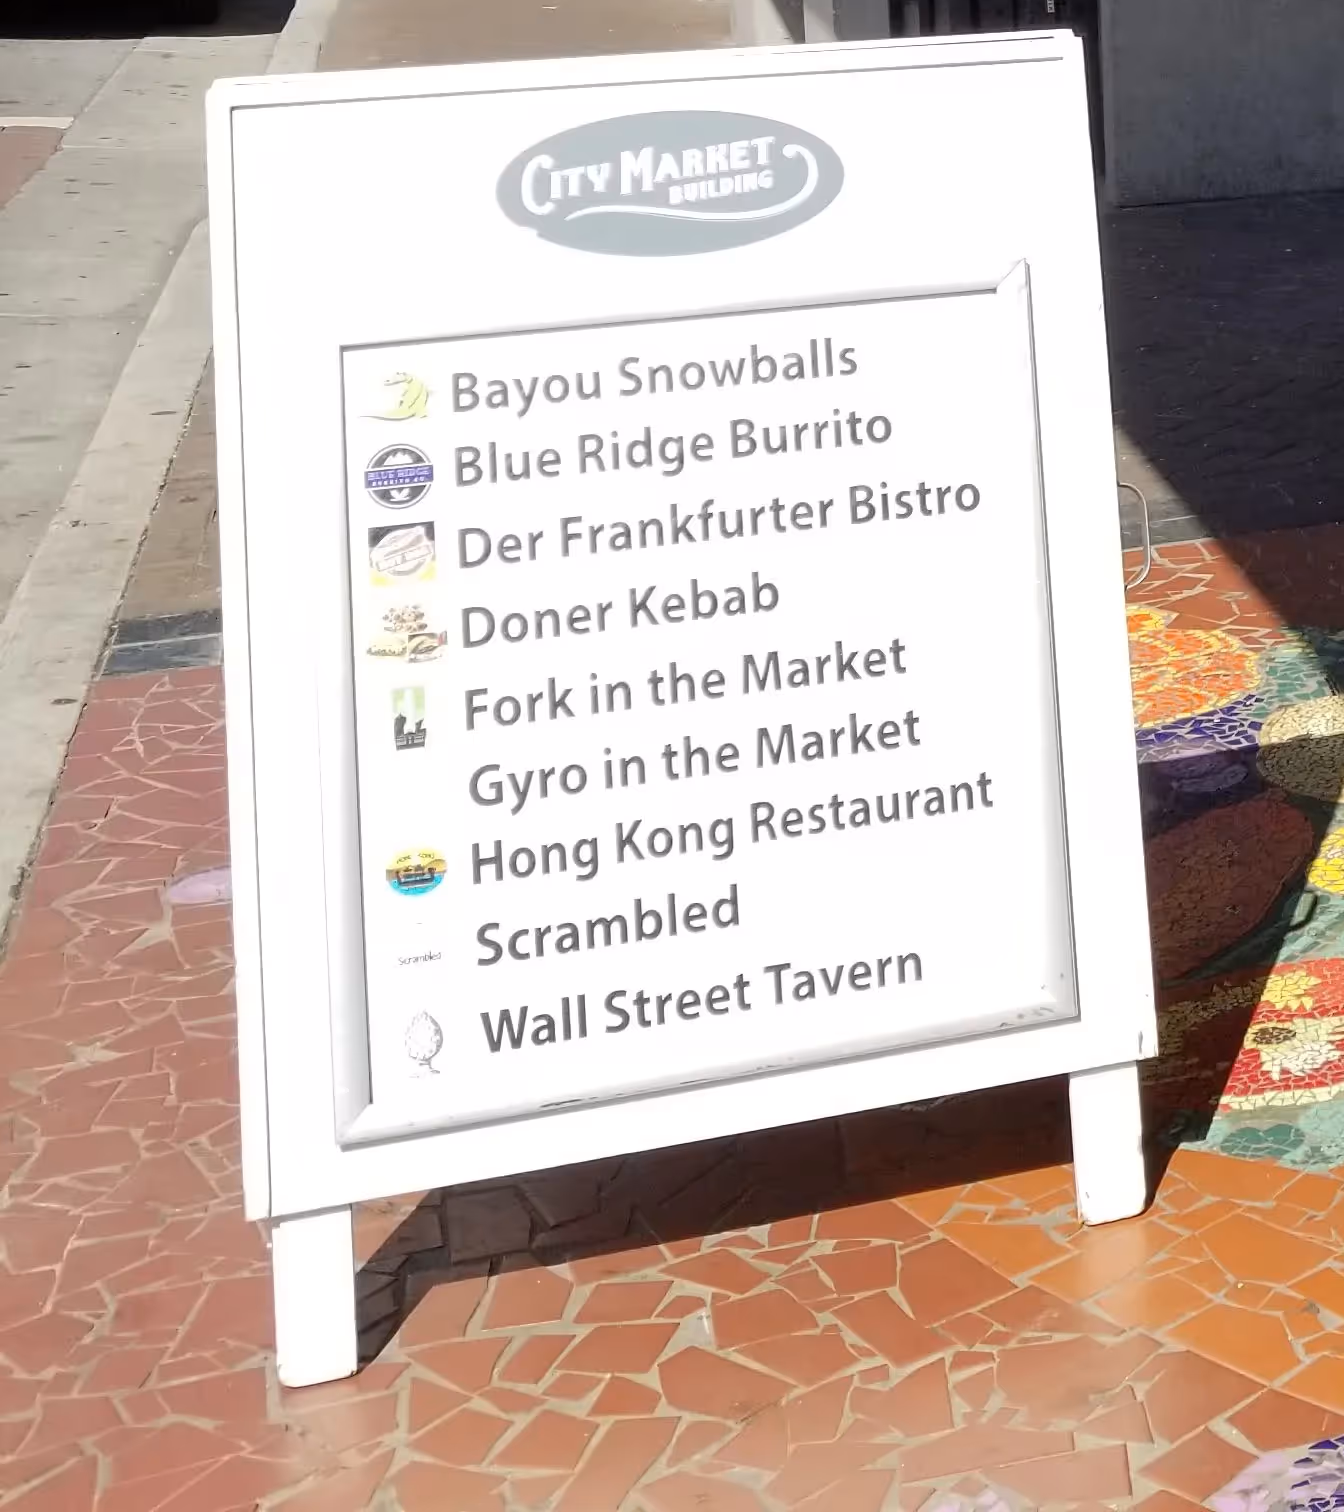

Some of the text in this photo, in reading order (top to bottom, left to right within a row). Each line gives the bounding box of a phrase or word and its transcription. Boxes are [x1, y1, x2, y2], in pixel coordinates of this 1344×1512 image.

[521, 136, 776, 216] CITY MARKET
[668, 170, 775, 205] BUILDING
[454, 338, 857, 417] Bayou Snowballs
[456, 409, 891, 486] Blue Ridge Burrito
[460, 528, 543, 568] Der
[562, 498, 833, 556] Frankfurter
[850, 482, 980, 524] Bistro
[463, 572, 778, 648] Doner Kebab
[466, 639, 906, 730] Fork in the Market
[470, 711, 920, 815] Gyro in the Market
[472, 772, 993, 884] Hong Kong Restaurant
[477, 884, 739, 966] Scrambled
[480, 953, 922, 1052] Wall Street Tavern
